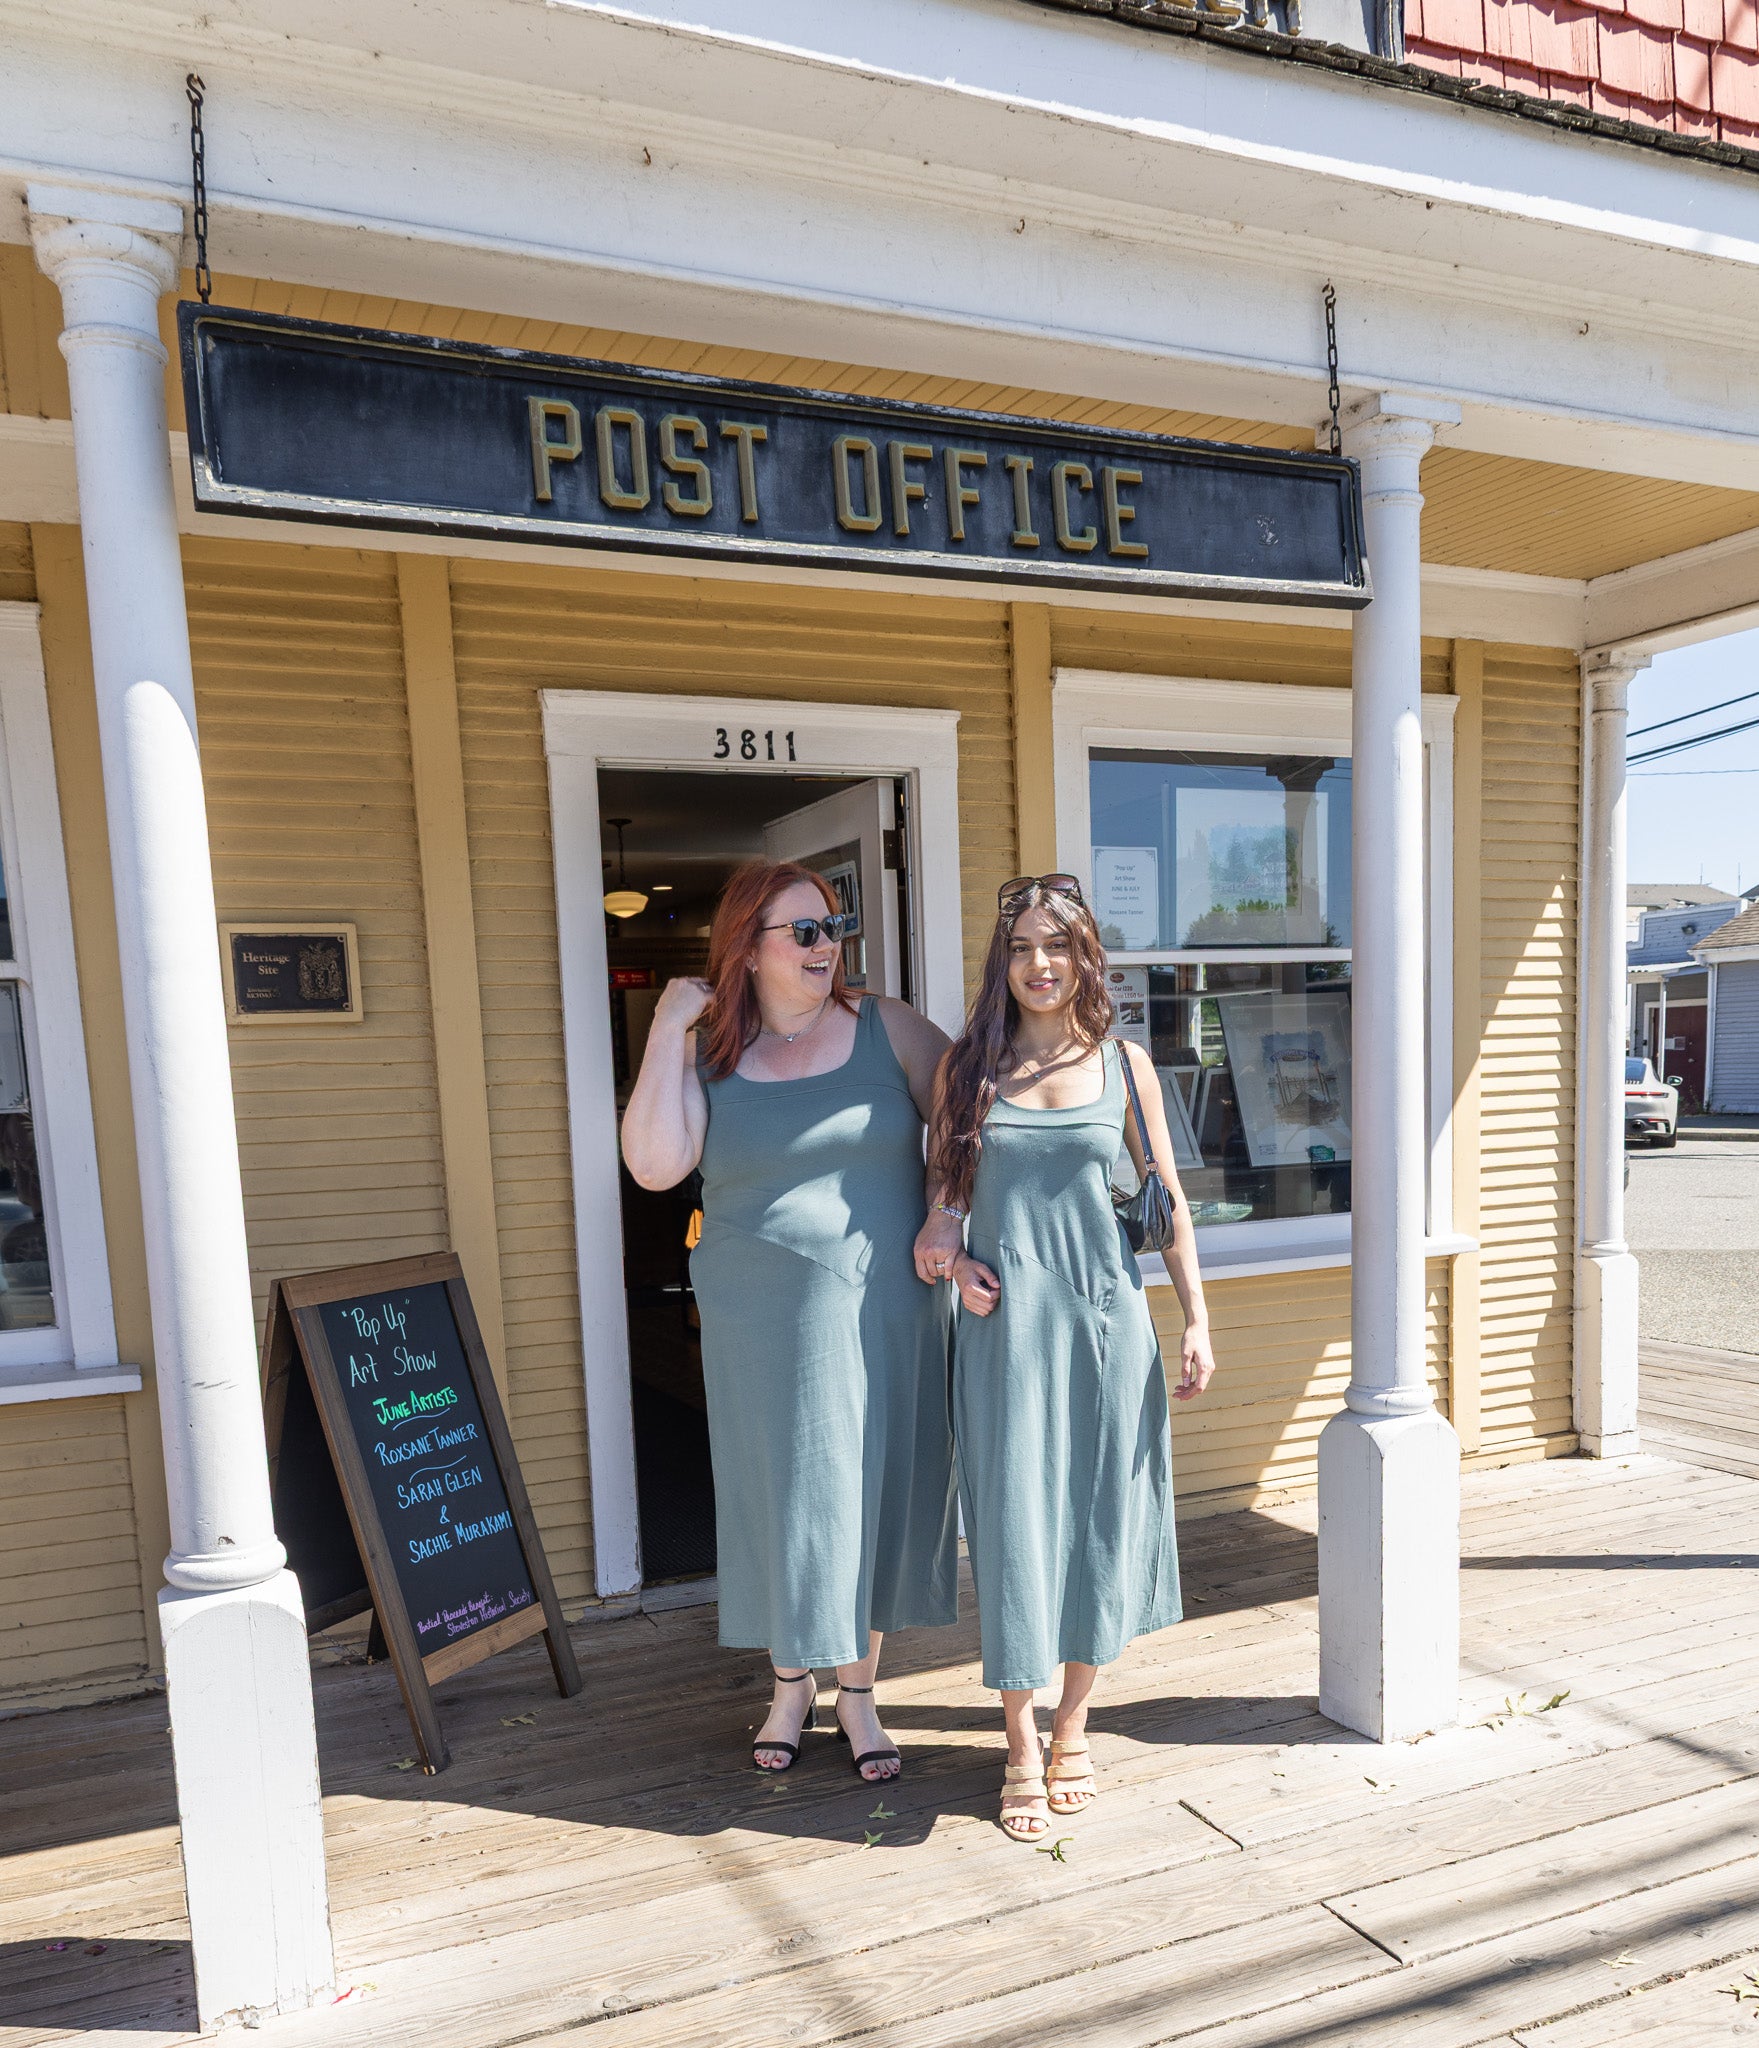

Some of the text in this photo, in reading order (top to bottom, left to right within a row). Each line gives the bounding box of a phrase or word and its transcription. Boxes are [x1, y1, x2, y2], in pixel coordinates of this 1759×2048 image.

[528, 396, 1150, 559] POST OFFICE
[713, 728, 797, 761] 3811
[242, 952, 290, 965] Heritage
[258, 965, 279, 975] Site
[349, 1346, 437, 1388] Art Show
[374, 1423, 479, 1467] ROXSANE TANNER
[397, 1465, 483, 1509] SARAH GLEN
[439, 1504, 451, 1525] &
[408, 1510, 513, 1564] SACHIE MURAKAMI
[447, 1587, 531, 1637] Steveston Historical Society
